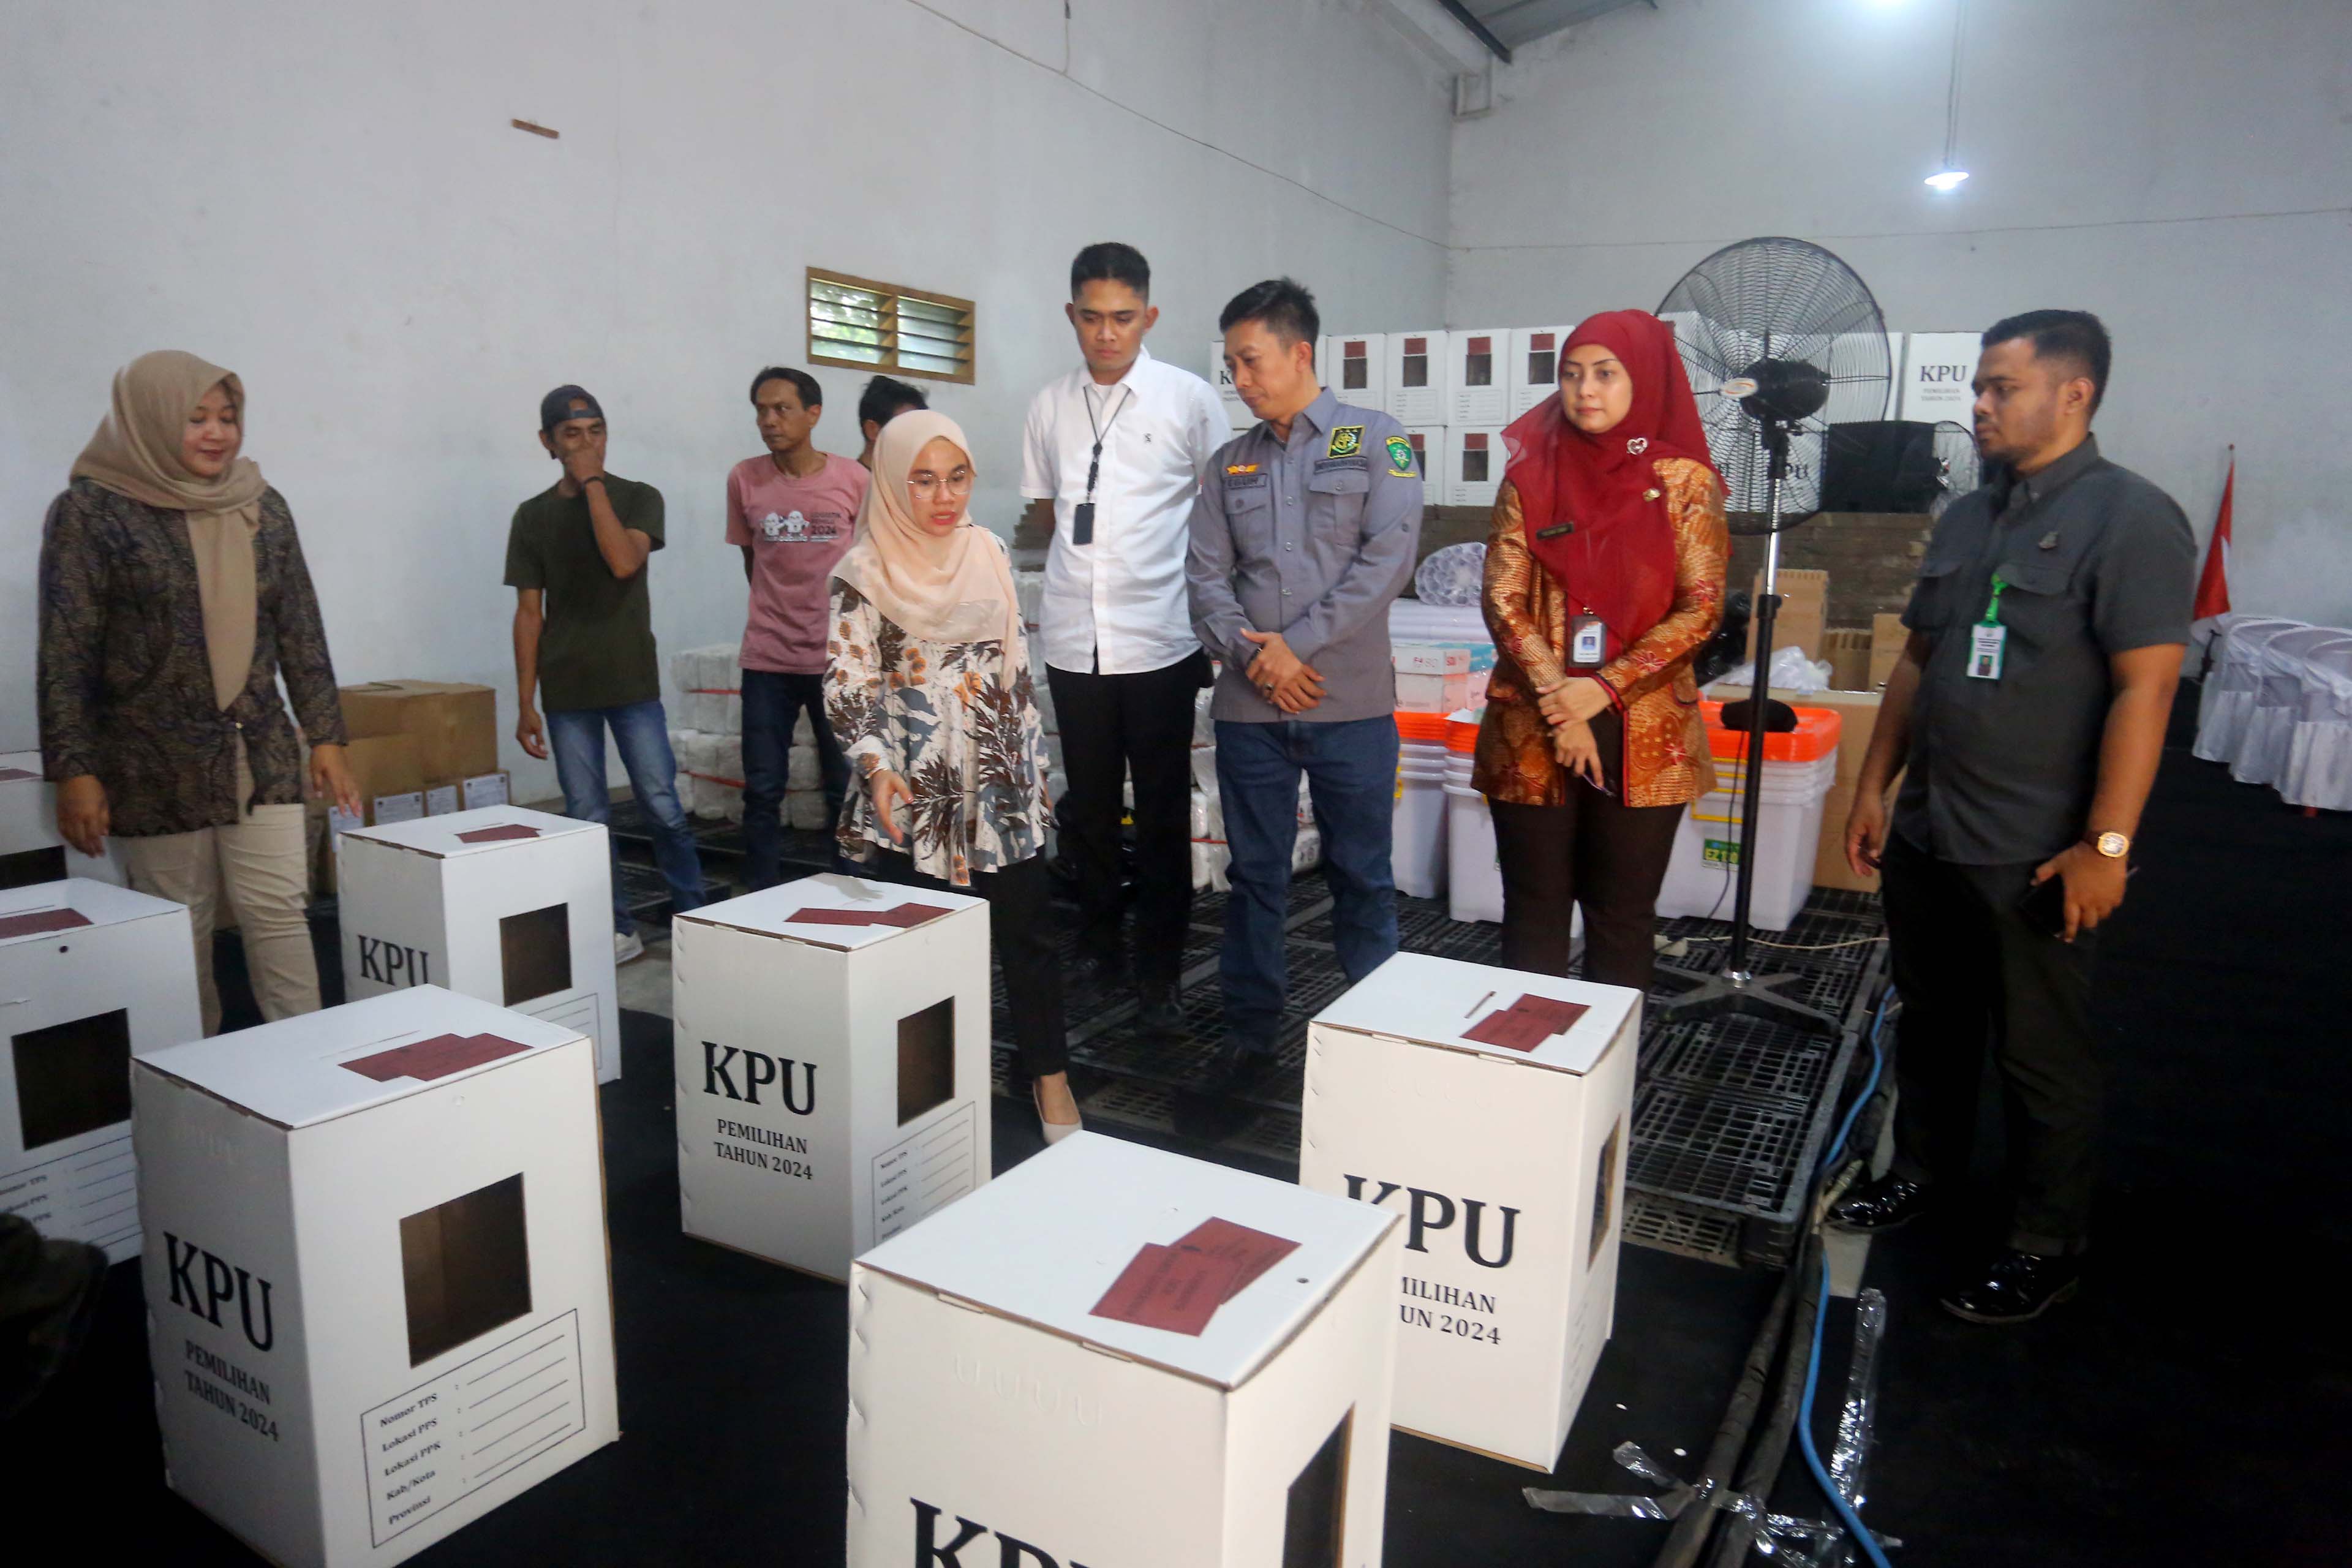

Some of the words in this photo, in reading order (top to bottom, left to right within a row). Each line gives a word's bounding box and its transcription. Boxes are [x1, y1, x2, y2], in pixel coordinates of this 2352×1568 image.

[1920, 365, 1967, 382] KPU
[358, 935, 428, 987] KPU
[701, 1041, 817, 1115] KPU
[717, 1118, 807, 1154] PEMILIHAN
[714, 1142, 767, 1169] TAHUN
[772, 1156, 813, 1180] 2024
[163, 1231, 274, 1352] KPU
[1441, 1315, 1501, 1344] 2024
[186, 1339, 270, 1404] PEMILIHAN
[185, 1370, 236, 1417] TAHUN
[239, 1402, 279, 1441] 2024
[379, 1405, 415, 1428] Nomor
[418, 1393, 438, 1409] TPS
[382, 1428, 417, 1452] Lokasi
[418, 1418, 438, 1434] PPS
[384, 1452, 418, 1477] Lokasi
[420, 1440, 442, 1458] PPK
[386, 1470, 436, 1501] Kab/Kota
[388, 1496, 431, 1525] Provinsi
